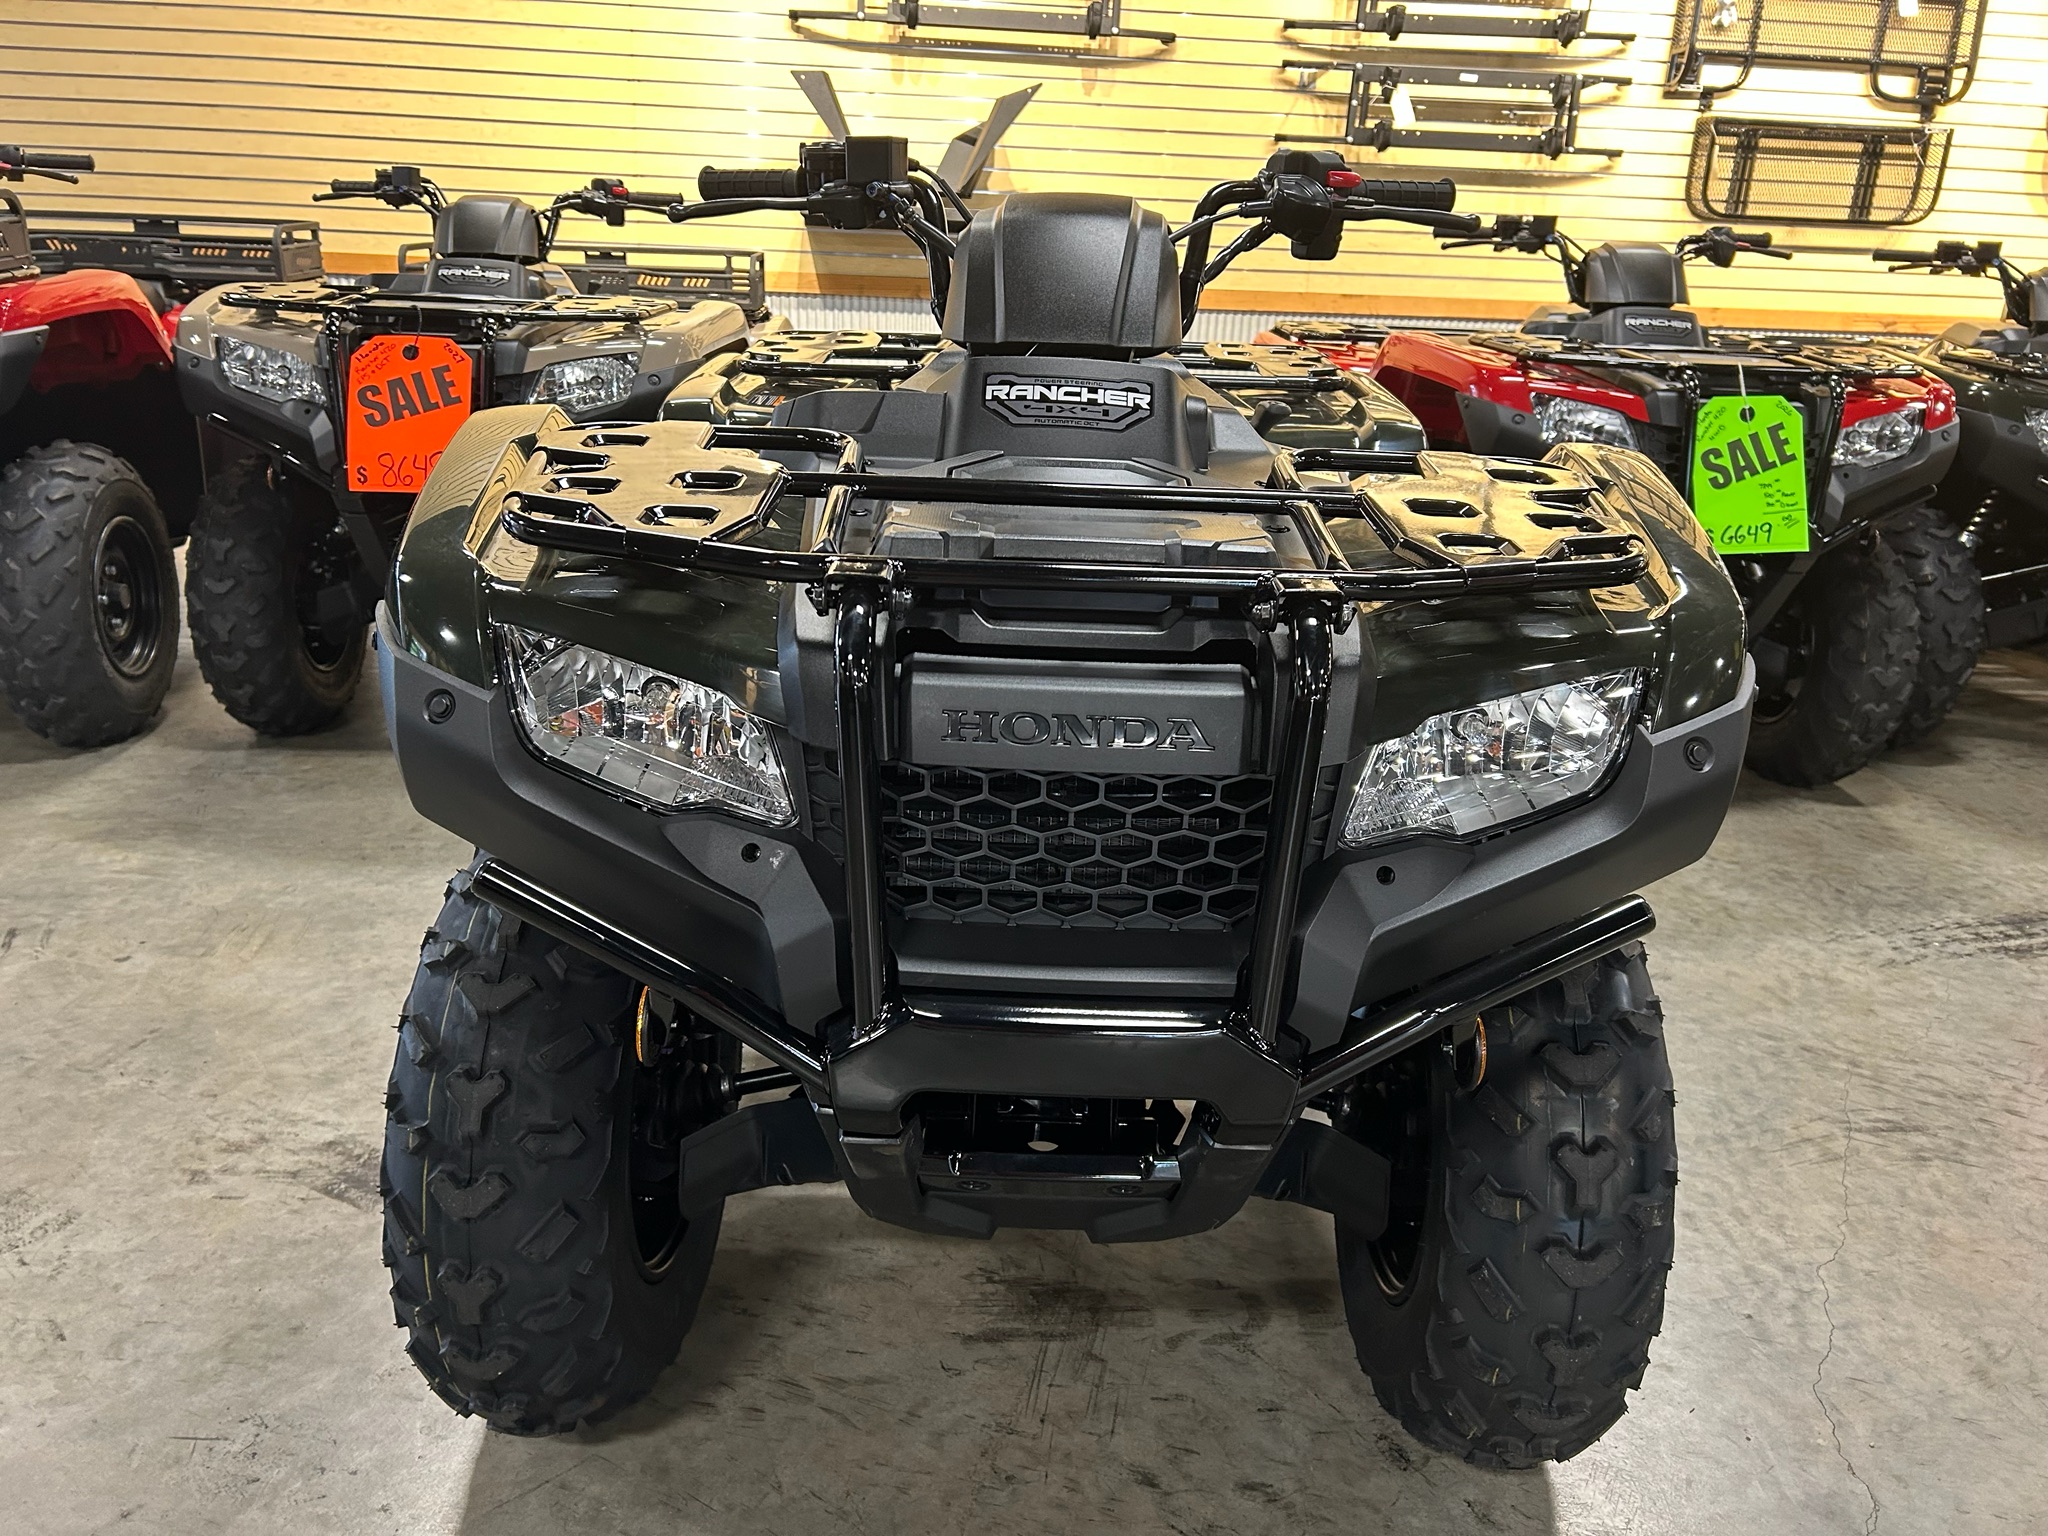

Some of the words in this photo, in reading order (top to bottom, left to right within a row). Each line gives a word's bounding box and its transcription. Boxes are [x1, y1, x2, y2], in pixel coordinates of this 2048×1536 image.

[438, 268, 510, 280] RANCHER
[1624, 317, 1692, 330] RANCHER
[1064, 379, 1104, 387] STEERING
[356, 364, 463, 428] SALE
[985, 384, 1151, 409] RANCHER
[1700, 421, 1798, 490] SALE
[356, 466, 368, 485] $
[940, 708, 1215, 752] HONDA
